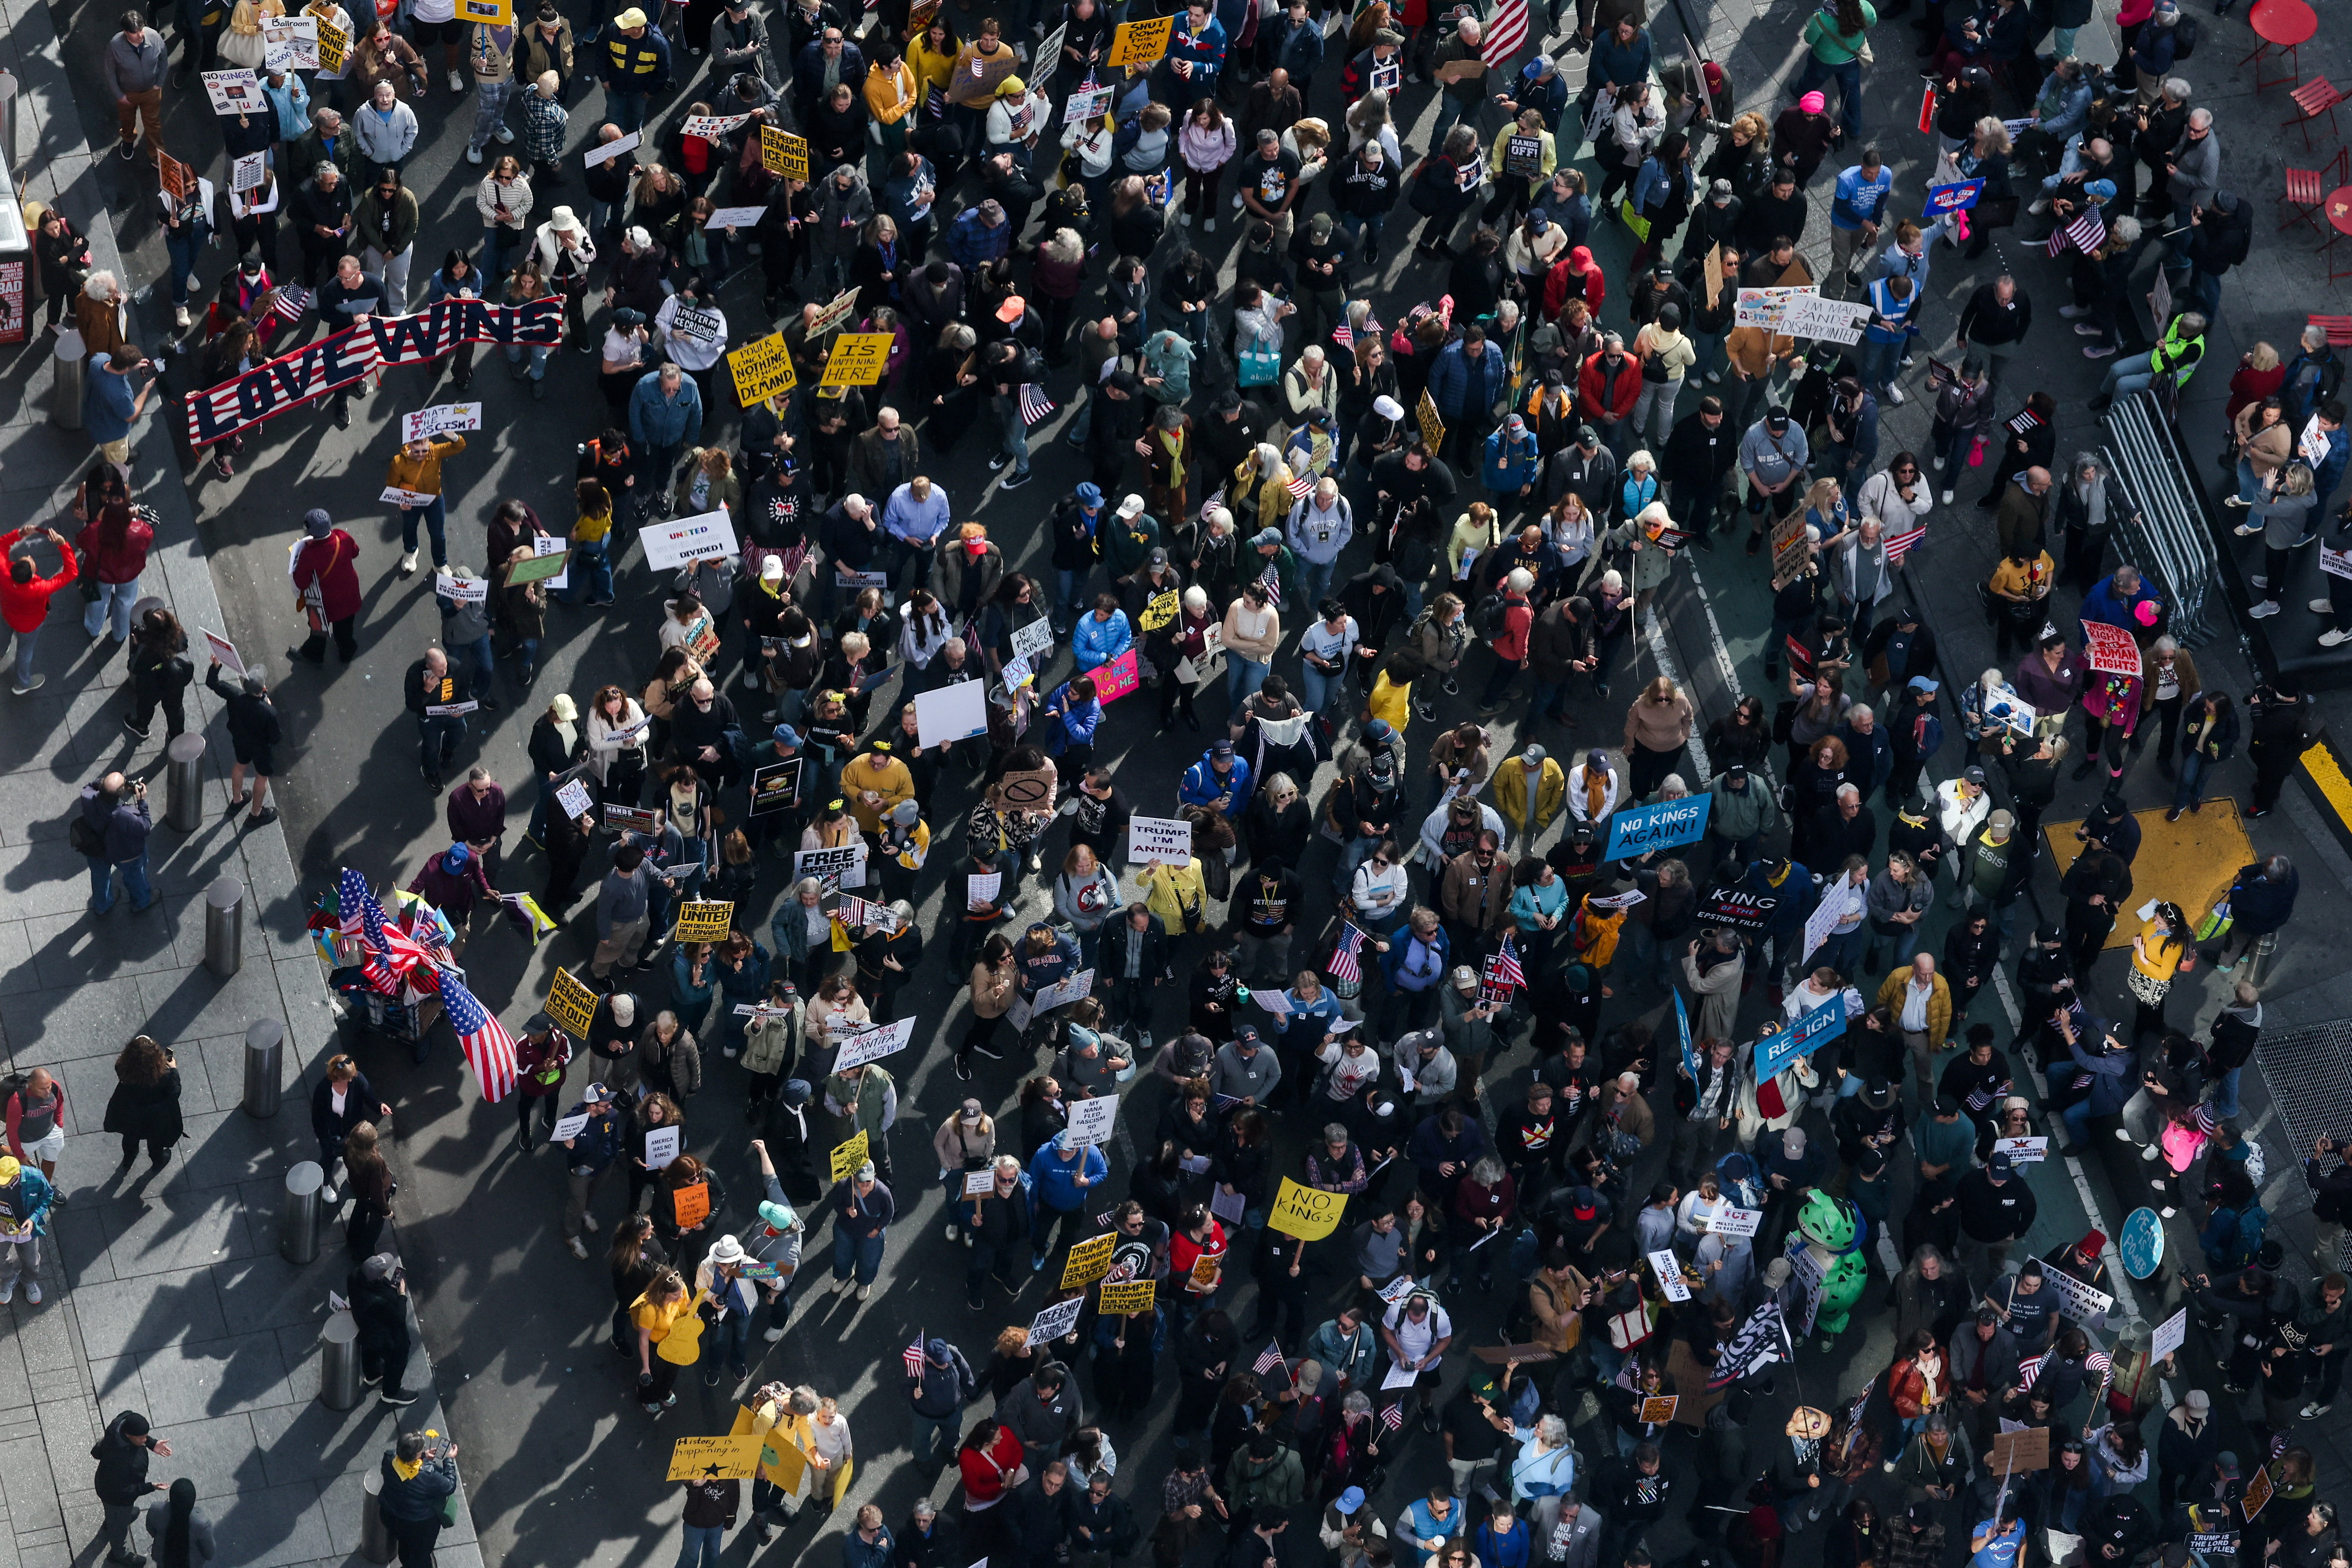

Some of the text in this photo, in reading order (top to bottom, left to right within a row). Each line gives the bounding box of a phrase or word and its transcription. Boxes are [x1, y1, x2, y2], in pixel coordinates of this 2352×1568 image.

[272, 18, 309, 27] Ballroom
[1130, 20, 1167, 30] SHUT
[1129, 28, 1165, 39] DOWN
[267, 51, 292, 68] 55,000
[294, 51, 319, 67] 90,000
[1121, 51, 1158, 62] KING
[220, 71, 253, 81] KINGS
[763, 129, 806, 148] THE PEOPLE
[1511, 139, 1539, 148] HANDS
[763, 139, 806, 158] DEMAND
[1511, 147, 1538, 158] OFF!
[764, 150, 806, 171] ICE OUT
[1804, 301, 1858, 316] I'M MAD
[682, 309, 708, 325] PREFER
[708, 319, 719, 327] MY
[1803, 312, 1841, 324] AND
[673, 317, 715, 340] ICE CRUSHED
[1781, 319, 1859, 343] DISAPPOINTED
[839, 345, 875, 357] IS
[736, 351, 786, 378] NOTHING
[830, 358, 878, 366] HAPPENING
[195, 301, 559, 444] LOVE WINS
[826, 367, 875, 380] HERE.
[741, 369, 793, 402] DEMAND
[411, 408, 444, 422] WHAT
[411, 418, 437, 430] THE
[411, 418, 476, 441] FASCISM?
[669, 526, 708, 540] UNITED
[1310, 524, 1338, 532] ARMY
[438, 588, 483, 598] EVERYWHERE
[687, 618, 707, 644] DEMOCRACY
[1019, 627, 1030, 639] NO
[2089, 631, 2130, 643] RIGHTS
[1024, 631, 1052, 655] KINGS!
[2095, 647, 2136, 660] HUMAN
[1003, 652, 1030, 692] RESIST
[1096, 661, 1128, 685] TO BE
[2094, 659, 2136, 673] RIGHTS
[1119, 674, 1135, 688] ME
[813, 726, 840, 735] KAKISTOCRACY
[774, 771, 795, 779] SANDWICH
[560, 783, 576, 799] NO
[561, 787, 585, 807] SECRET
[775, 787, 792, 795] BREAD
[567, 797, 591, 817] POLICE
[606, 806, 632, 816] HANDS
[1652, 802, 1677, 812] 1776
[1621, 807, 1699, 833] NO KINGS
[1135, 826, 1189, 838] TRUMP,
[1617, 821, 1694, 849] AGAIN!
[1153, 836, 1173, 845] I'M
[1643, 840, 1674, 851] 2026
[801, 847, 856, 867] FREE
[1133, 845, 1188, 856] ANTIFA
[800, 862, 855, 874] SPEECH
[821, 876, 839, 890] PROTECT
[821, 886, 838, 900] DEMOCRACY
[1711, 889, 1777, 909] KING
[701, 903, 733, 911] PEOPLE
[1736, 907, 1755, 916] THE
[681, 909, 731, 922] UNITED
[1697, 911, 1764, 928] EPSTIEN FILES
[1028, 955, 1062, 966] VIRGINIA
[852, 1023, 899, 1048] HELL YEAH
[1768, 1009, 1836, 1060] RESIGN
[855, 1034, 895, 1054] ANTIFA
[839, 1040, 904, 1070] EVERY WW2 VET!
[1782, 1042, 1815, 1064] PROJECT
[1076, 1116, 1106, 1126] FASCISM
[651, 1137, 674, 1146] AMERICA
[1072, 1131, 1107, 1143] WOULDN'T
[655, 1151, 670, 1159] KINGS
[1293, 1189, 1331, 1210] NO
[1277, 1197, 1334, 1223] KINGS
[1724, 1208, 1749, 1220] ICE
[2136, 1213, 2163, 1256] PEACE
[2138, 1236, 2145, 1250] IS
[2124, 1234, 2146, 1273] POWER
[1800, 1253, 1816, 1275] MANY
[1104, 1284, 1143, 1293] TRUMP
[2046, 1267, 2103, 1299] FEDERALLY
[1104, 1290, 1152, 1299] NETANYAHU
[1037, 1300, 1081, 1323] DEFEND
[1101, 1302, 1152, 1311] GENOCIDE!
[2069, 1300, 2090, 1315] THE
[677, 1438, 716, 1447] History
[674, 1447, 728, 1459] happening
